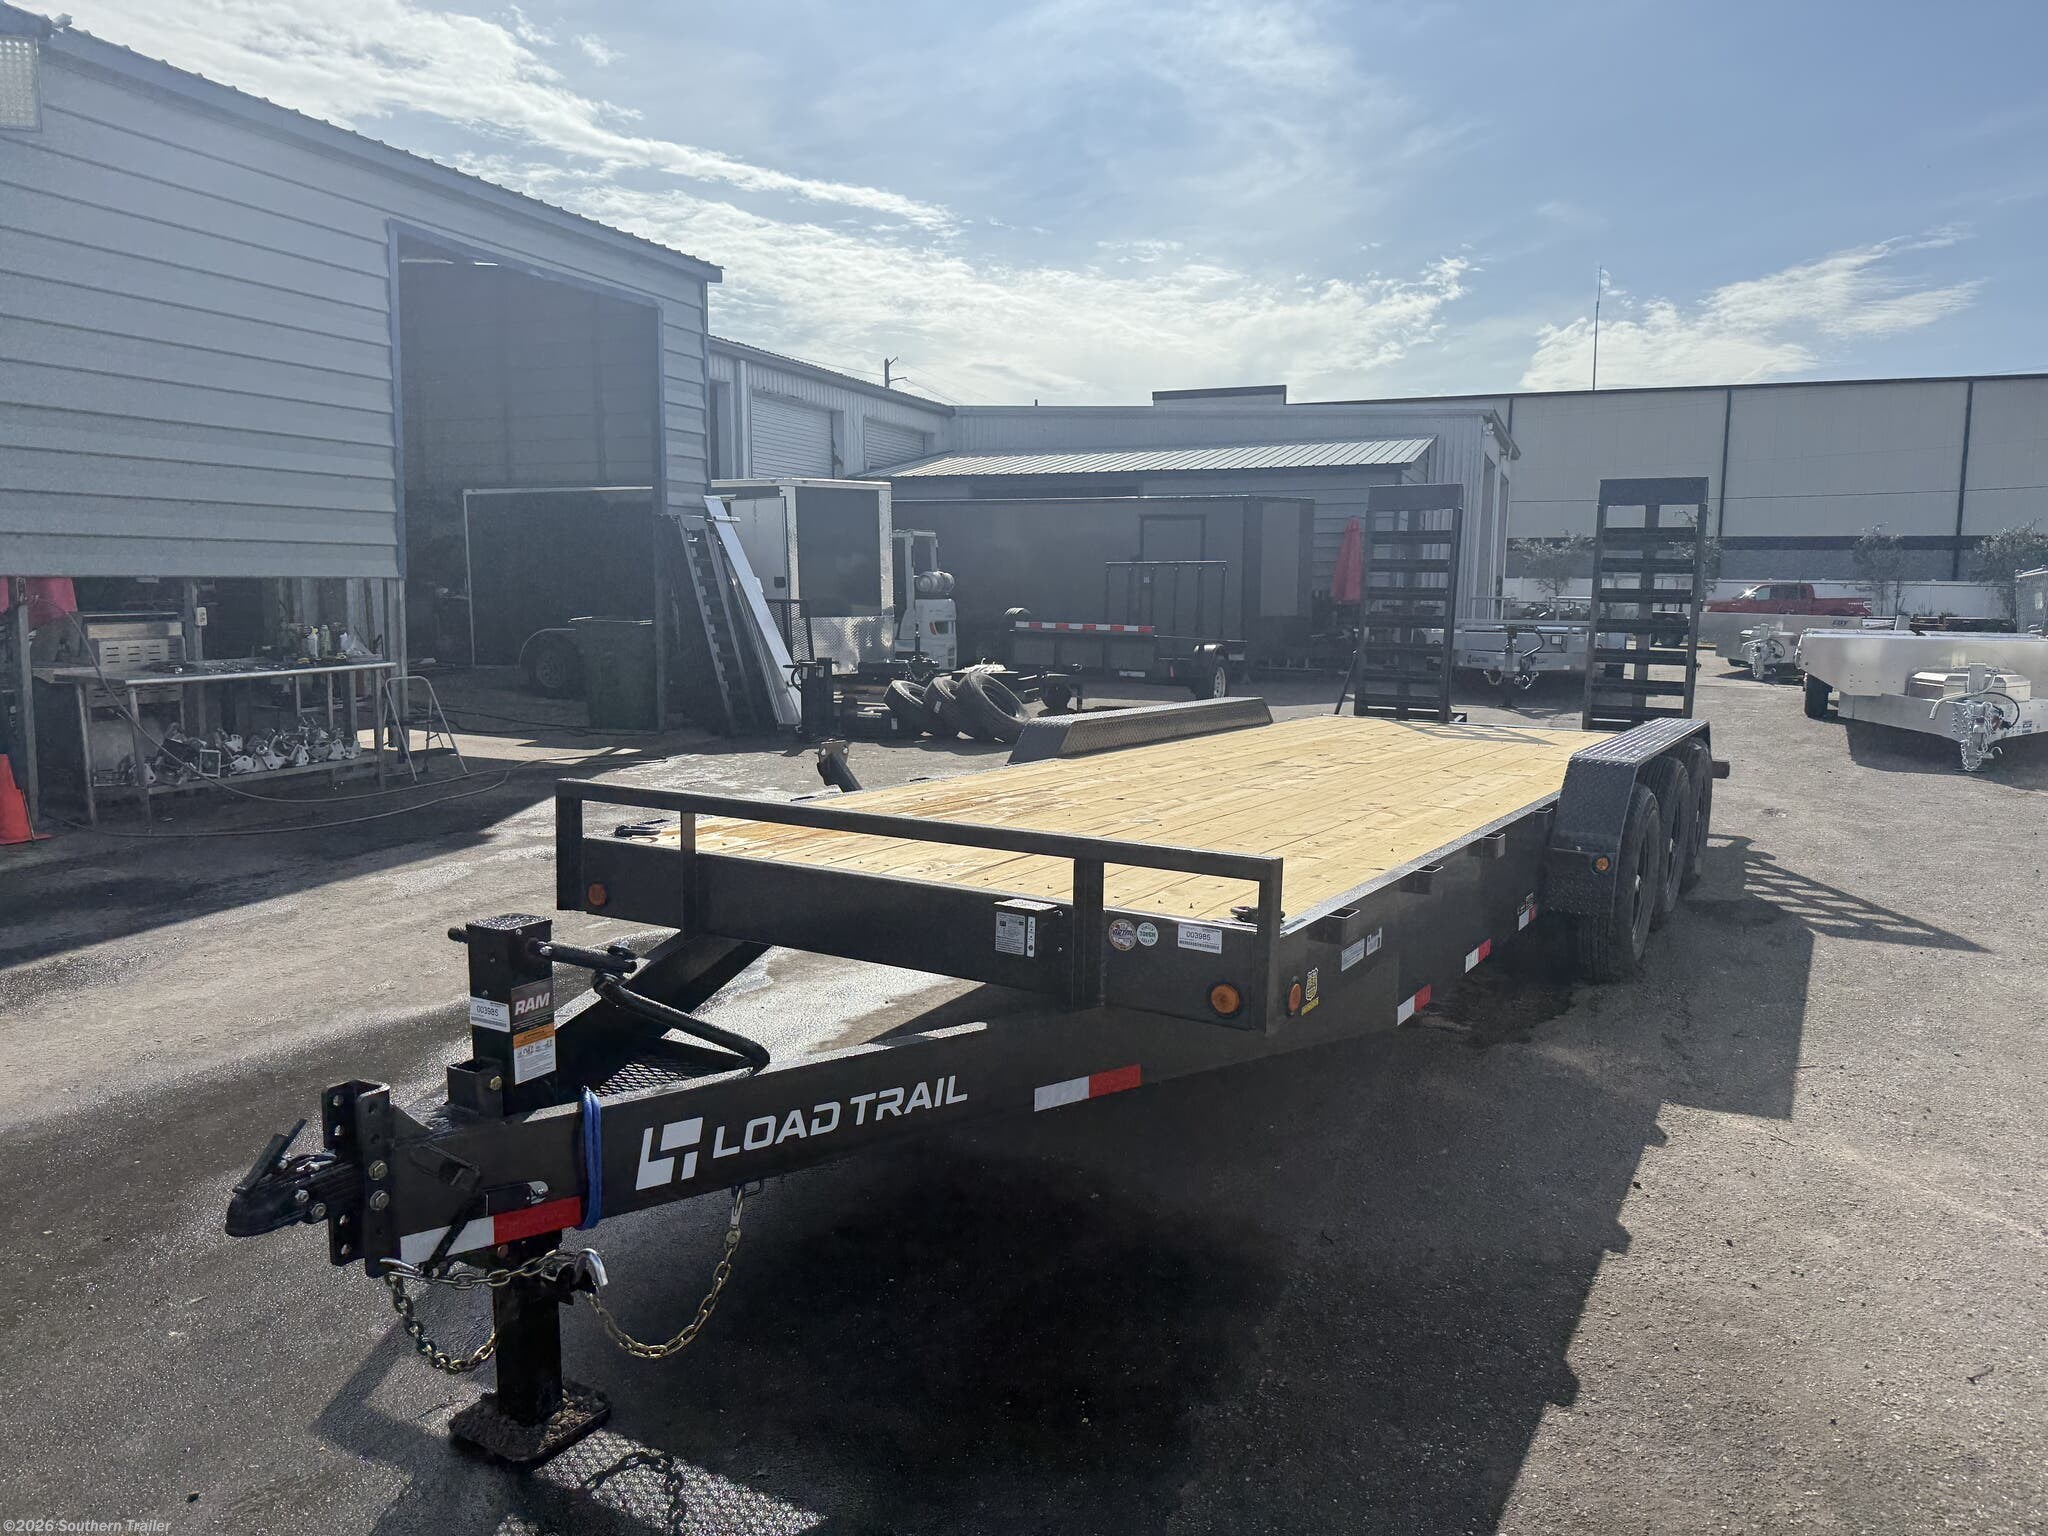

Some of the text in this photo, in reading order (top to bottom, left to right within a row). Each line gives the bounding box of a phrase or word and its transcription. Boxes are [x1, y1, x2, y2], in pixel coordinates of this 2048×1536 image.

[514, 992, 550, 1016] RAM
[713, 1075, 968, 1159] LOAD TRAIL
